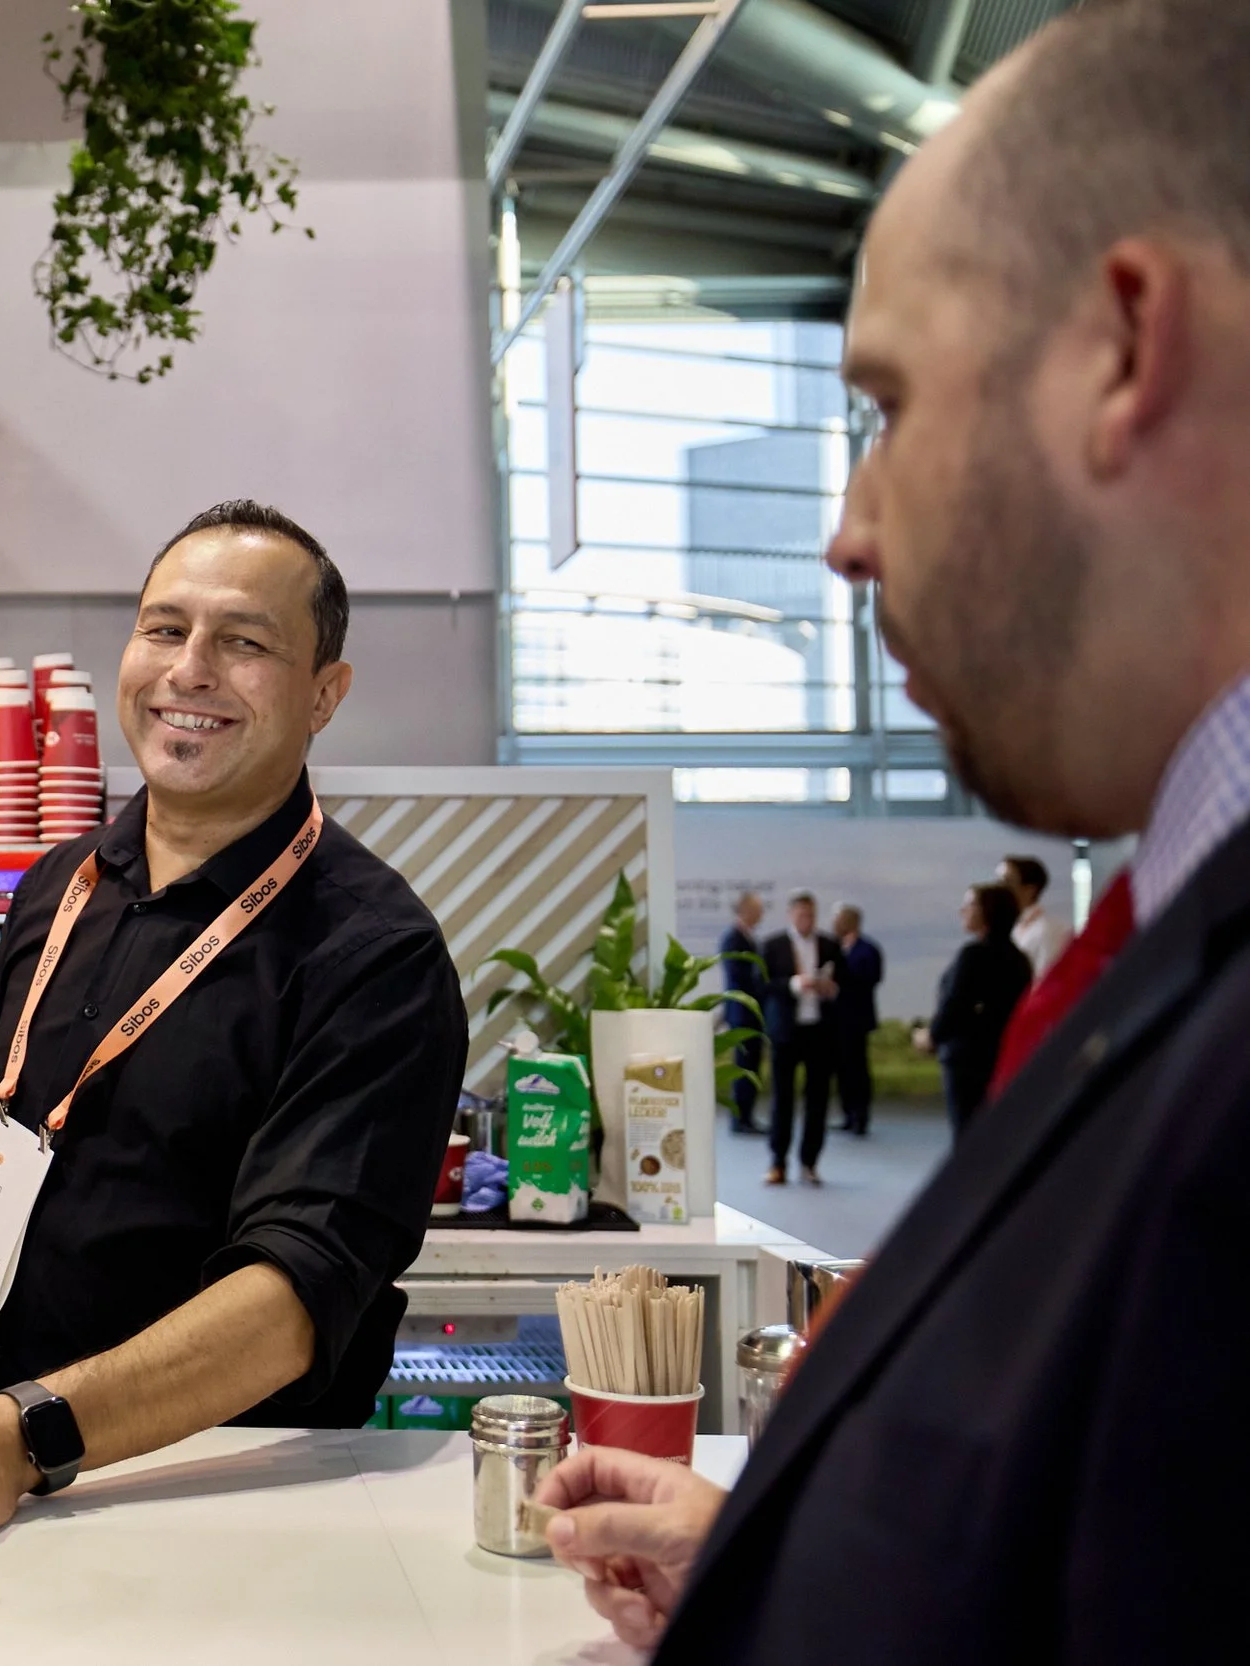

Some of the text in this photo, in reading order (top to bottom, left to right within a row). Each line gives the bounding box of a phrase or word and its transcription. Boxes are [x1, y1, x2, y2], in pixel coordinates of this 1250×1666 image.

[292, 826, 317, 860] Sibos
[63, 875, 91, 913] Sibos
[240, 877, 278, 914] Sibos
[35, 944, 59, 986] Sibos
[180, 934, 220, 975] Sibos
[120, 997, 161, 1037] Sibos
[11, 1019, 29, 1064] Sibos
